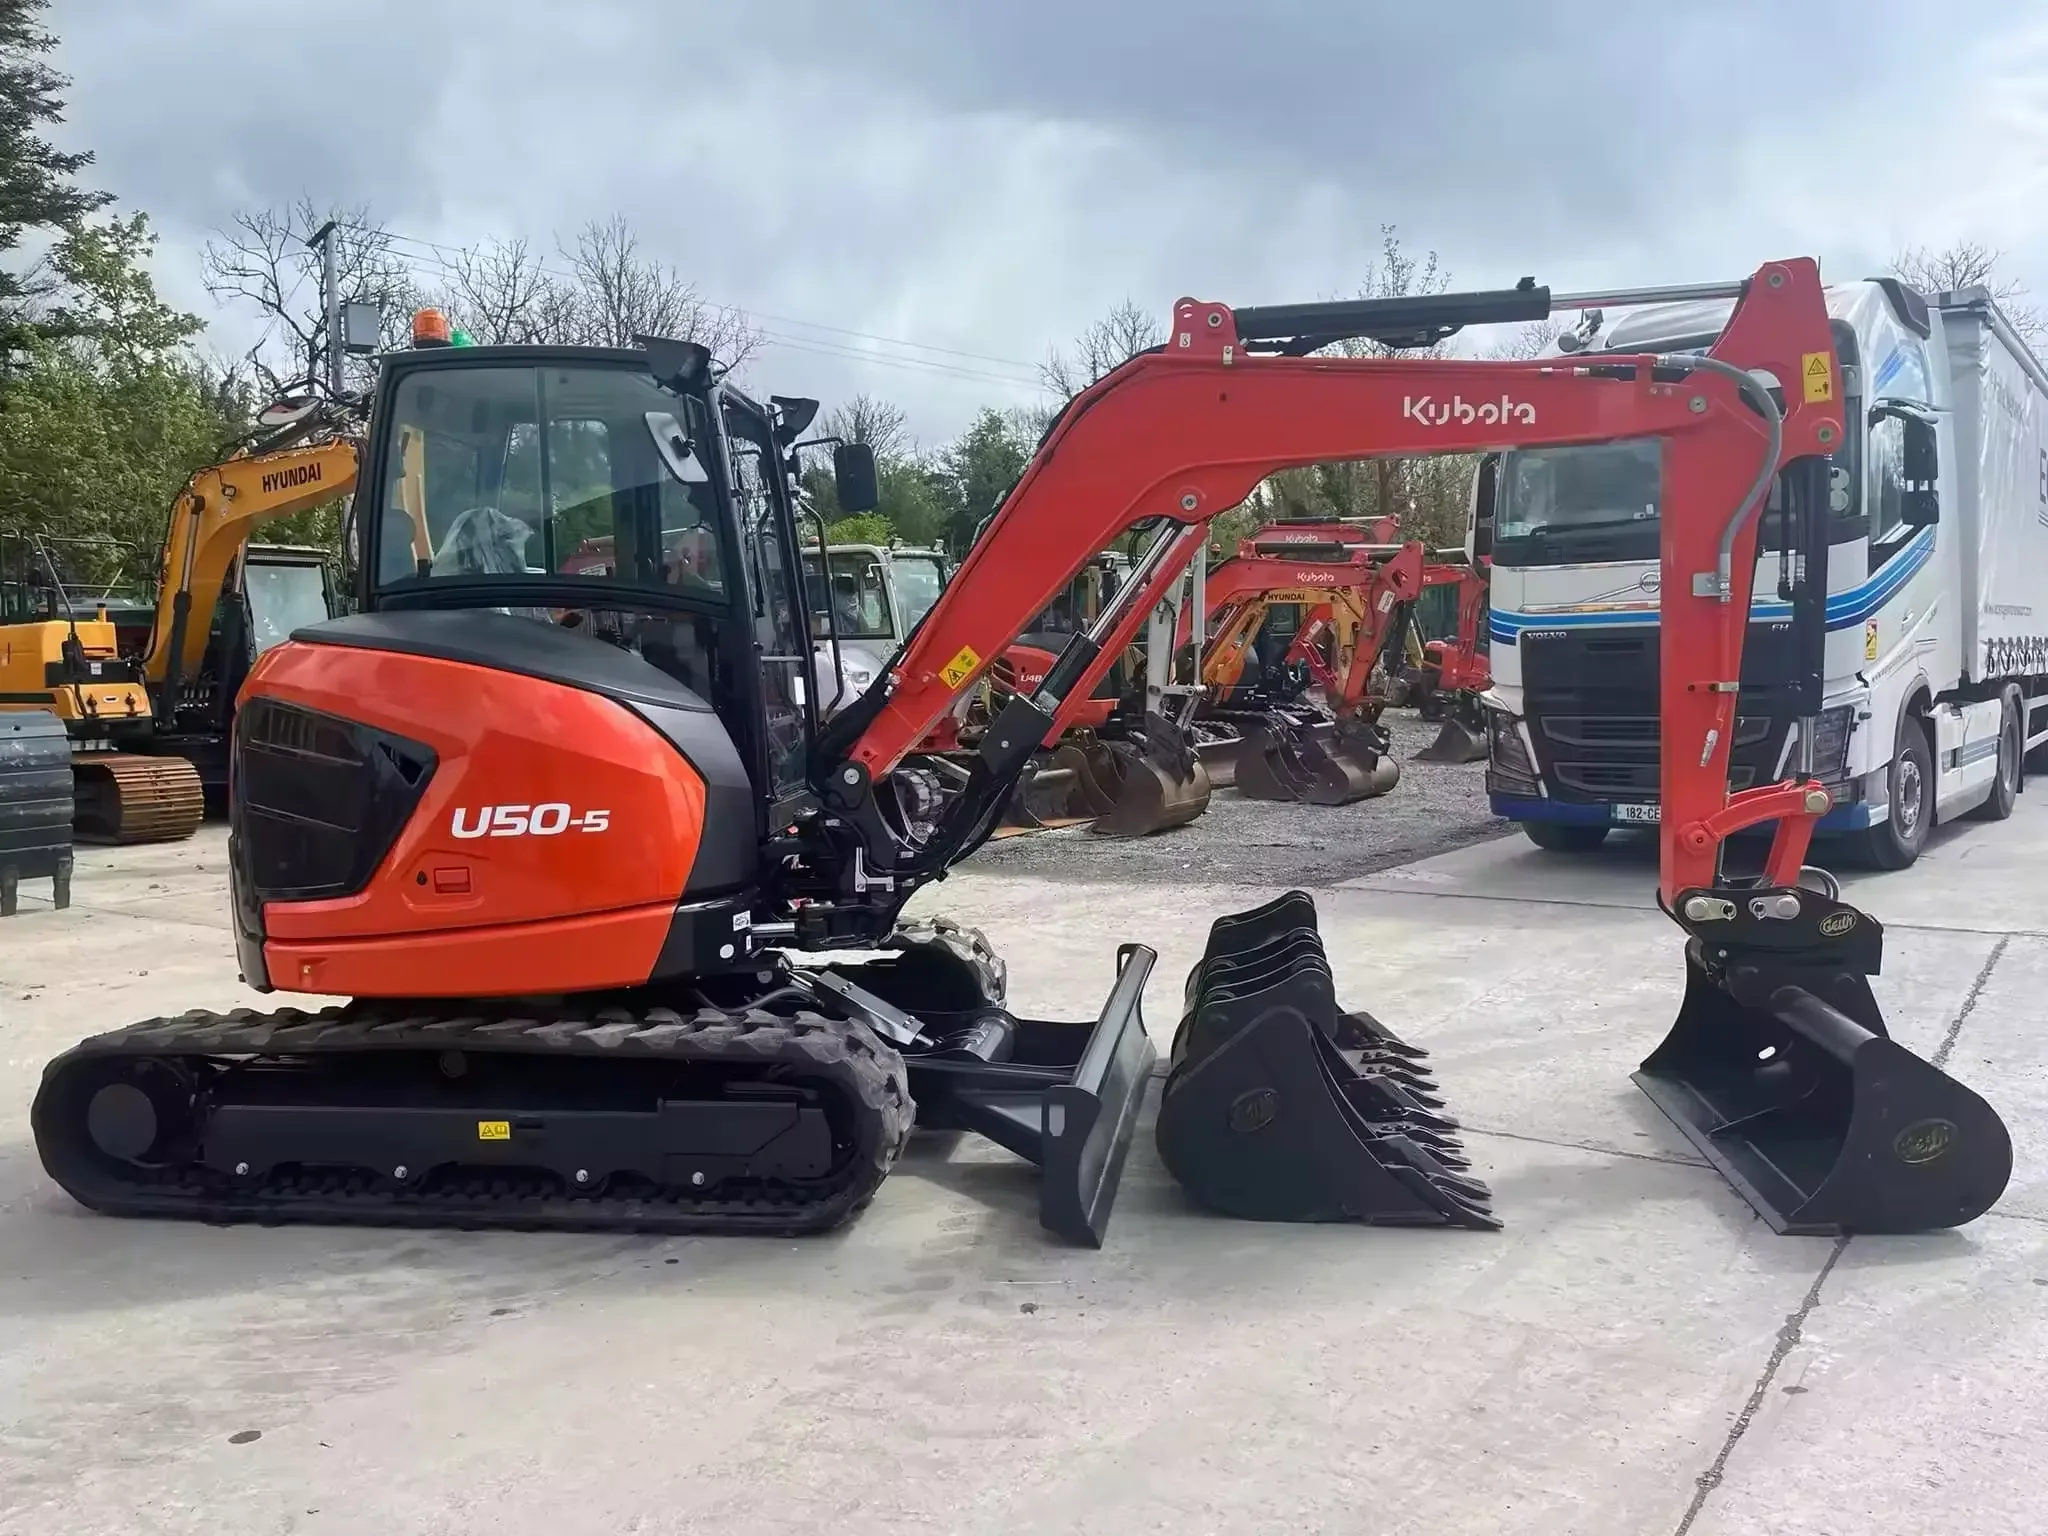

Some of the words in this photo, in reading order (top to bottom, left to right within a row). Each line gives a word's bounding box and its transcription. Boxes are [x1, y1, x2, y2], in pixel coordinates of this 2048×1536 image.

[1403, 394, 1536, 425] Kubota
[262, 462, 321, 493] HYUNDAI
[1285, 533, 1318, 544] Kubota
[1297, 571, 1335, 583] Kubota
[1268, 592, 1305, 601] HYUNDAI
[1527, 631, 1567, 640] VOLVO
[451, 803, 611, 839] U50-5
